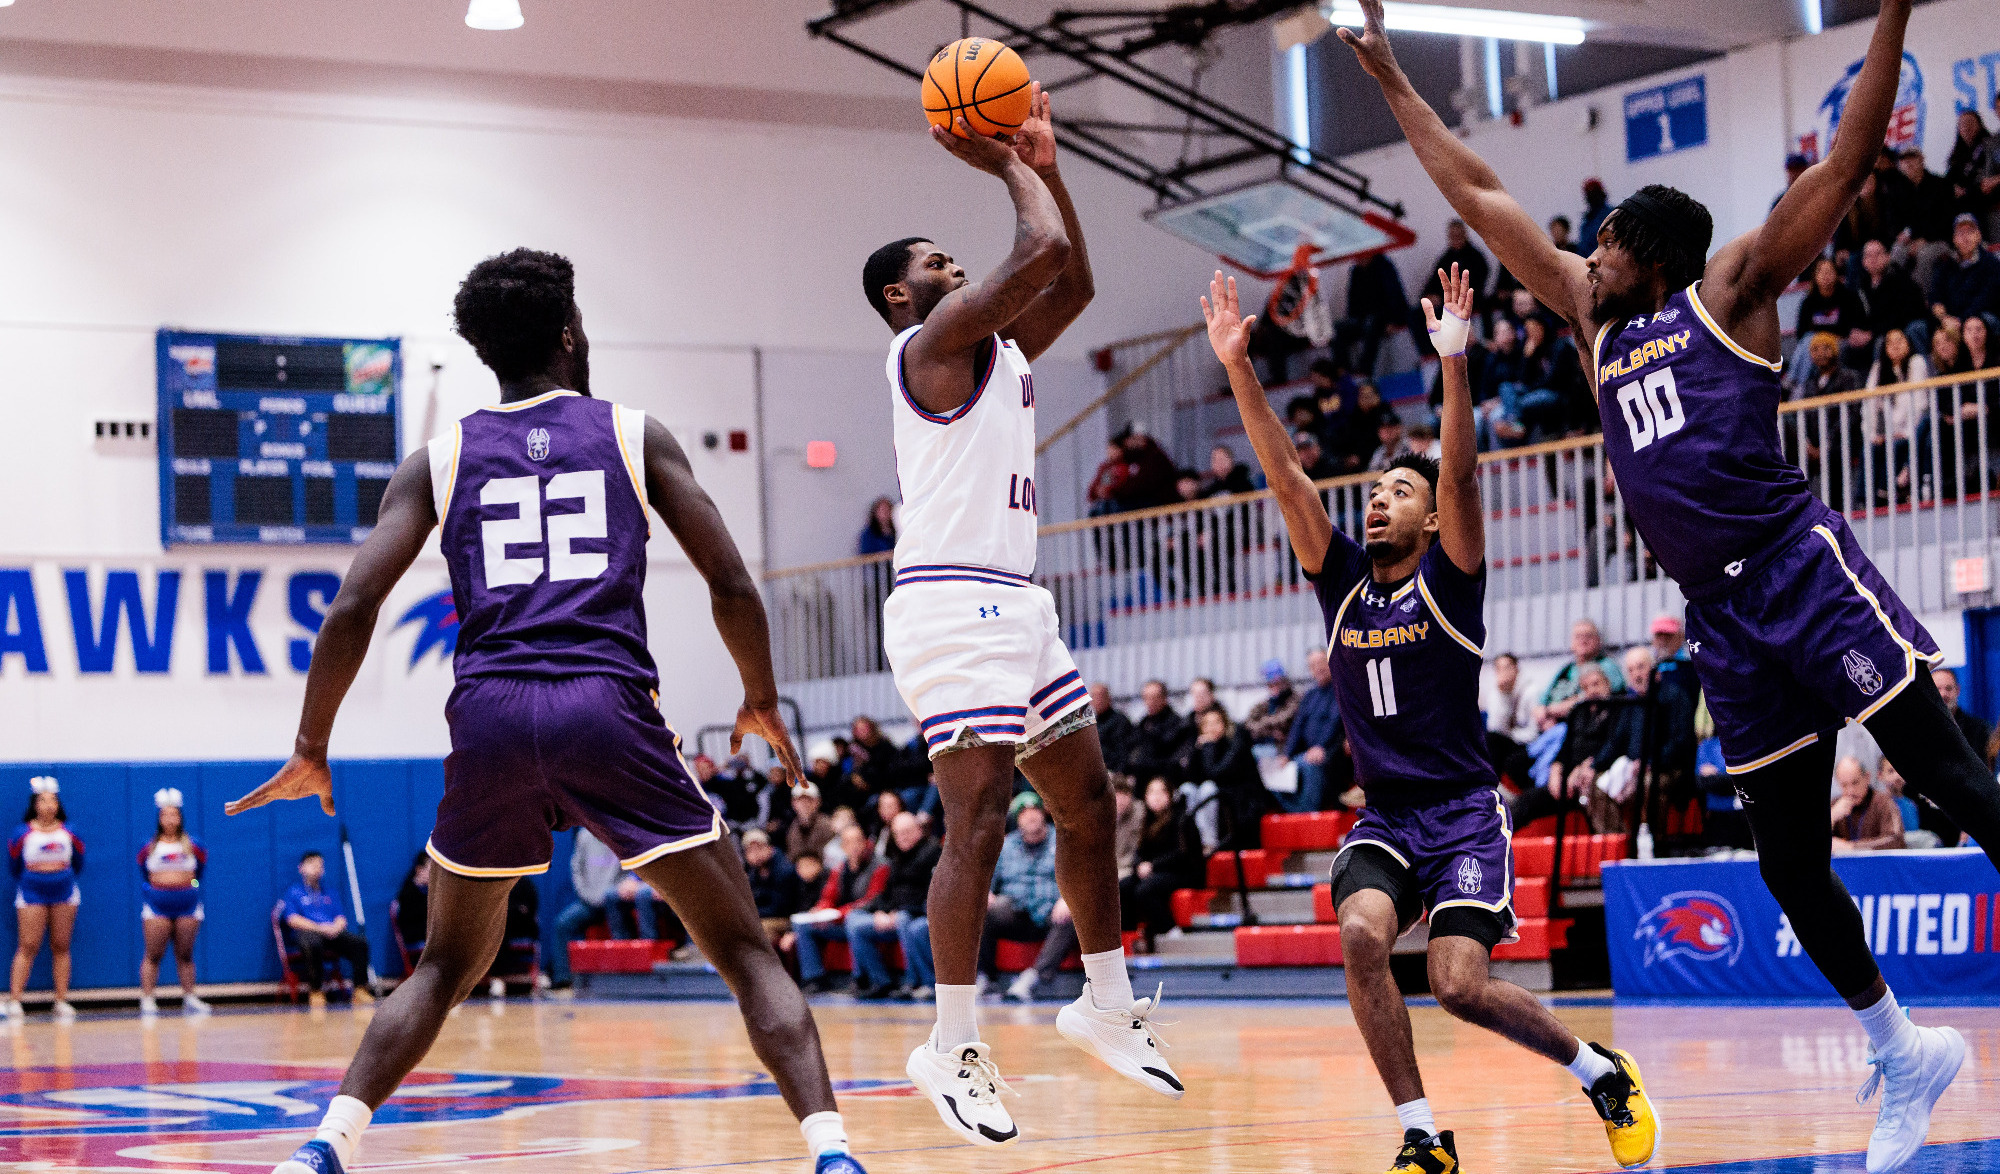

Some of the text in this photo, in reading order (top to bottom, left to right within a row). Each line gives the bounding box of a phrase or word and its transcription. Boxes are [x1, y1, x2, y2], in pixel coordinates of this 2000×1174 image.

[1657, 113, 1675, 153] 1
[1616, 366, 1686, 453] 00
[480, 470, 609, 589] 22
[1340, 621, 1429, 649] UALBANY
[1366, 657, 1398, 717] 11
